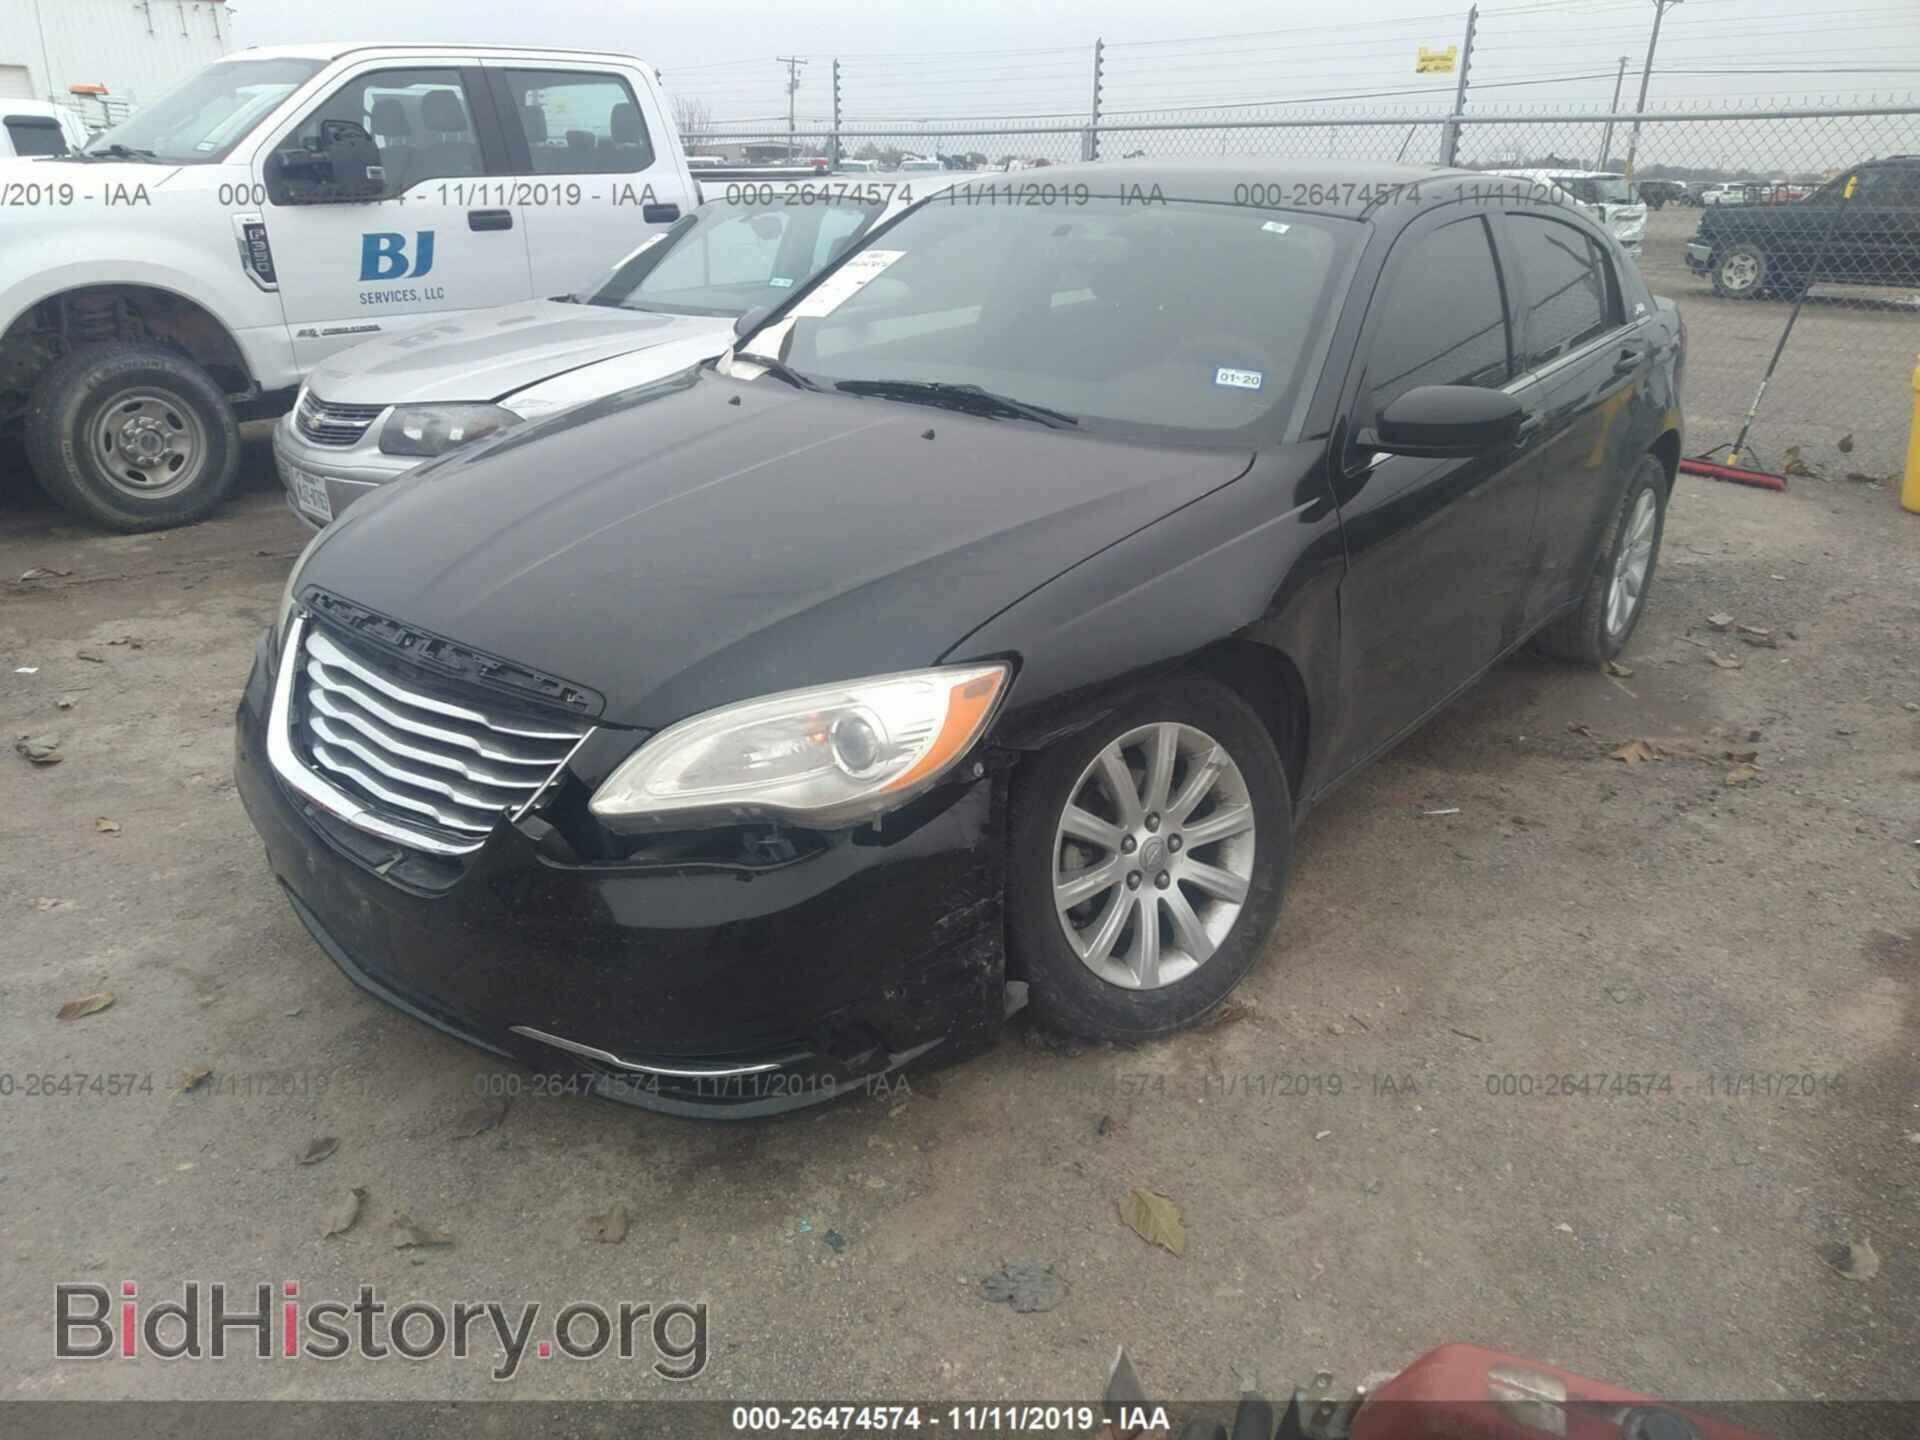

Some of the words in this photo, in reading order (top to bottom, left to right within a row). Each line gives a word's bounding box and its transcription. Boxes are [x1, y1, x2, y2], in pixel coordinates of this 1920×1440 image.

[358, 230, 435, 281] BJ
[359, 289, 421, 305] SERVICES,
[424, 287, 445, 300] LLC
